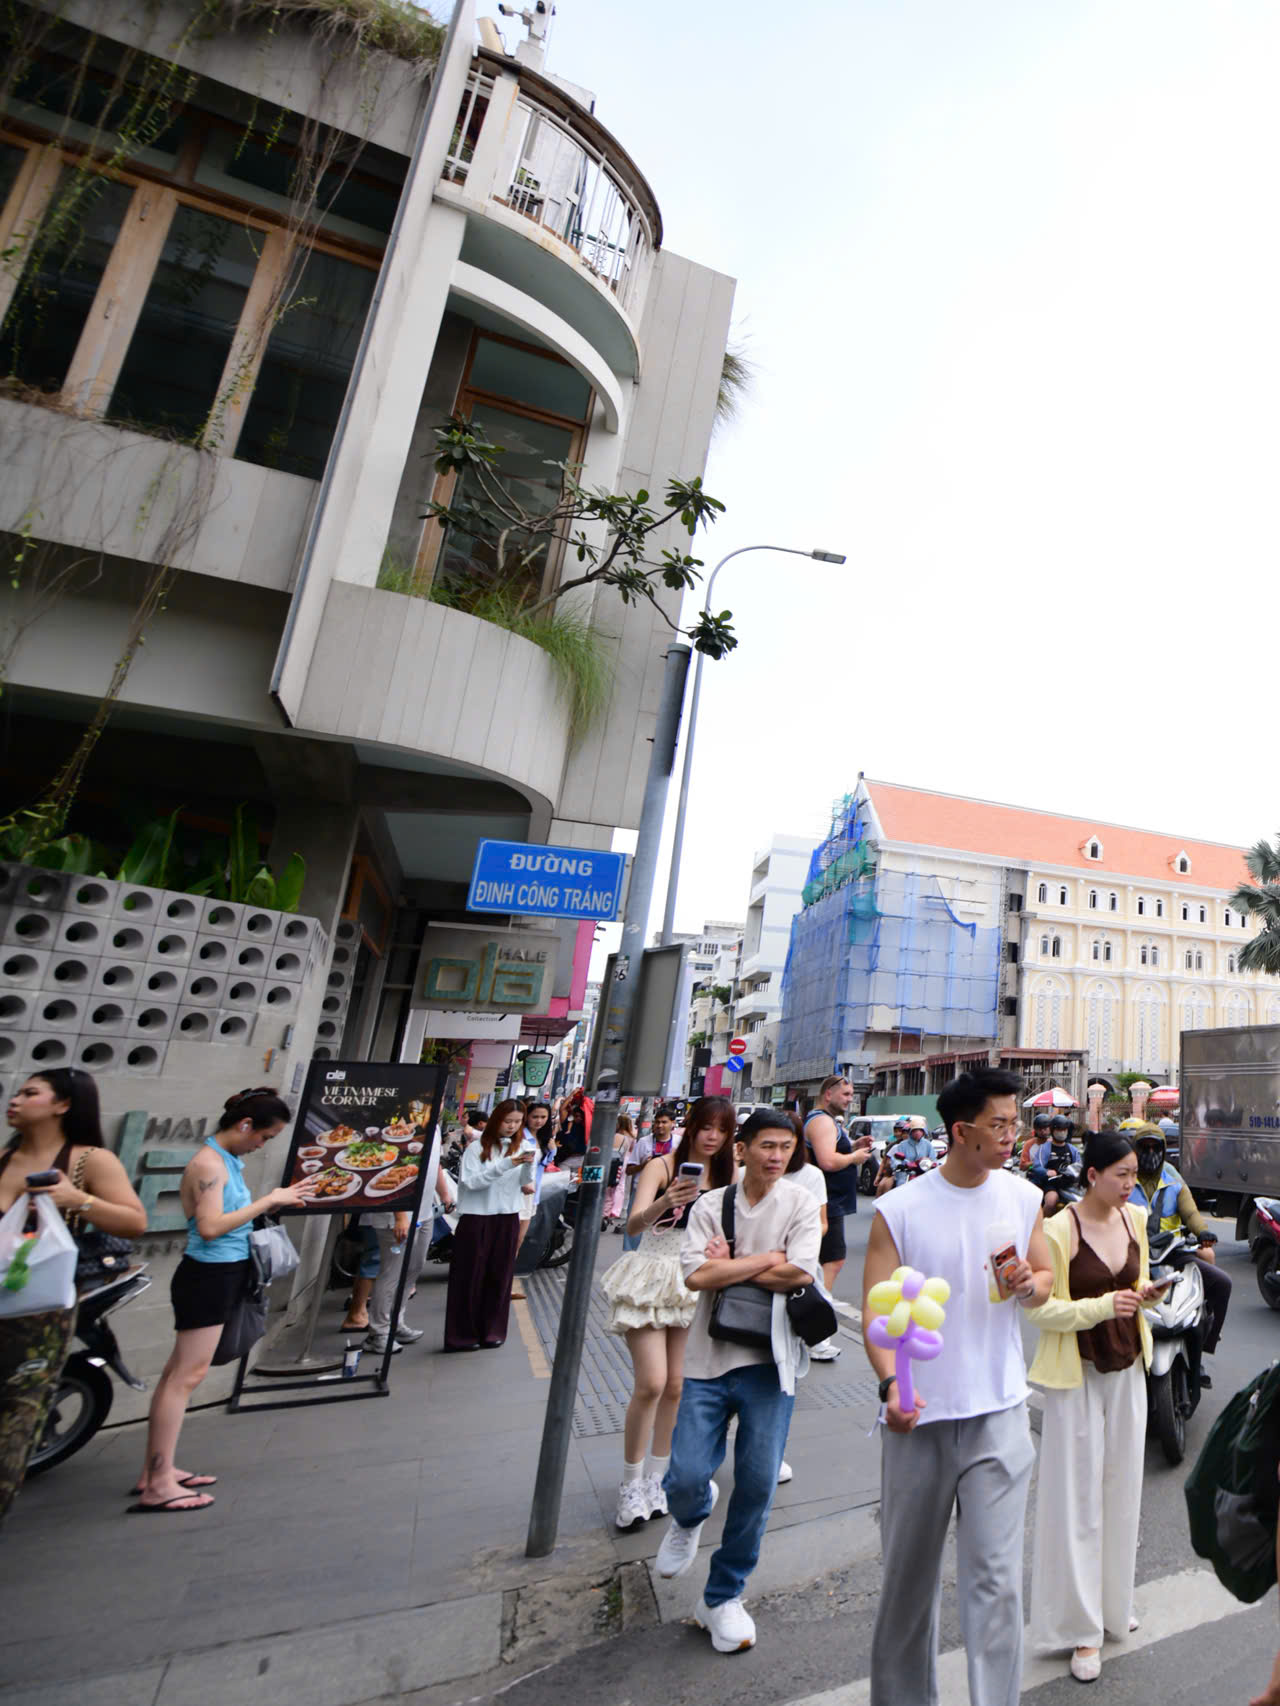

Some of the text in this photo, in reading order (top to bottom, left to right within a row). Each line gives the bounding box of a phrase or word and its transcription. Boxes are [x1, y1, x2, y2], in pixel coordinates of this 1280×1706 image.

[509, 852, 593, 876] ĐƯỜNG
[475, 880, 613, 912] ĐINH CÔNG TRÁNG
[324, 1086, 399, 1097] VIETNAMESE
[321, 1095, 377, 1106] CORNER
